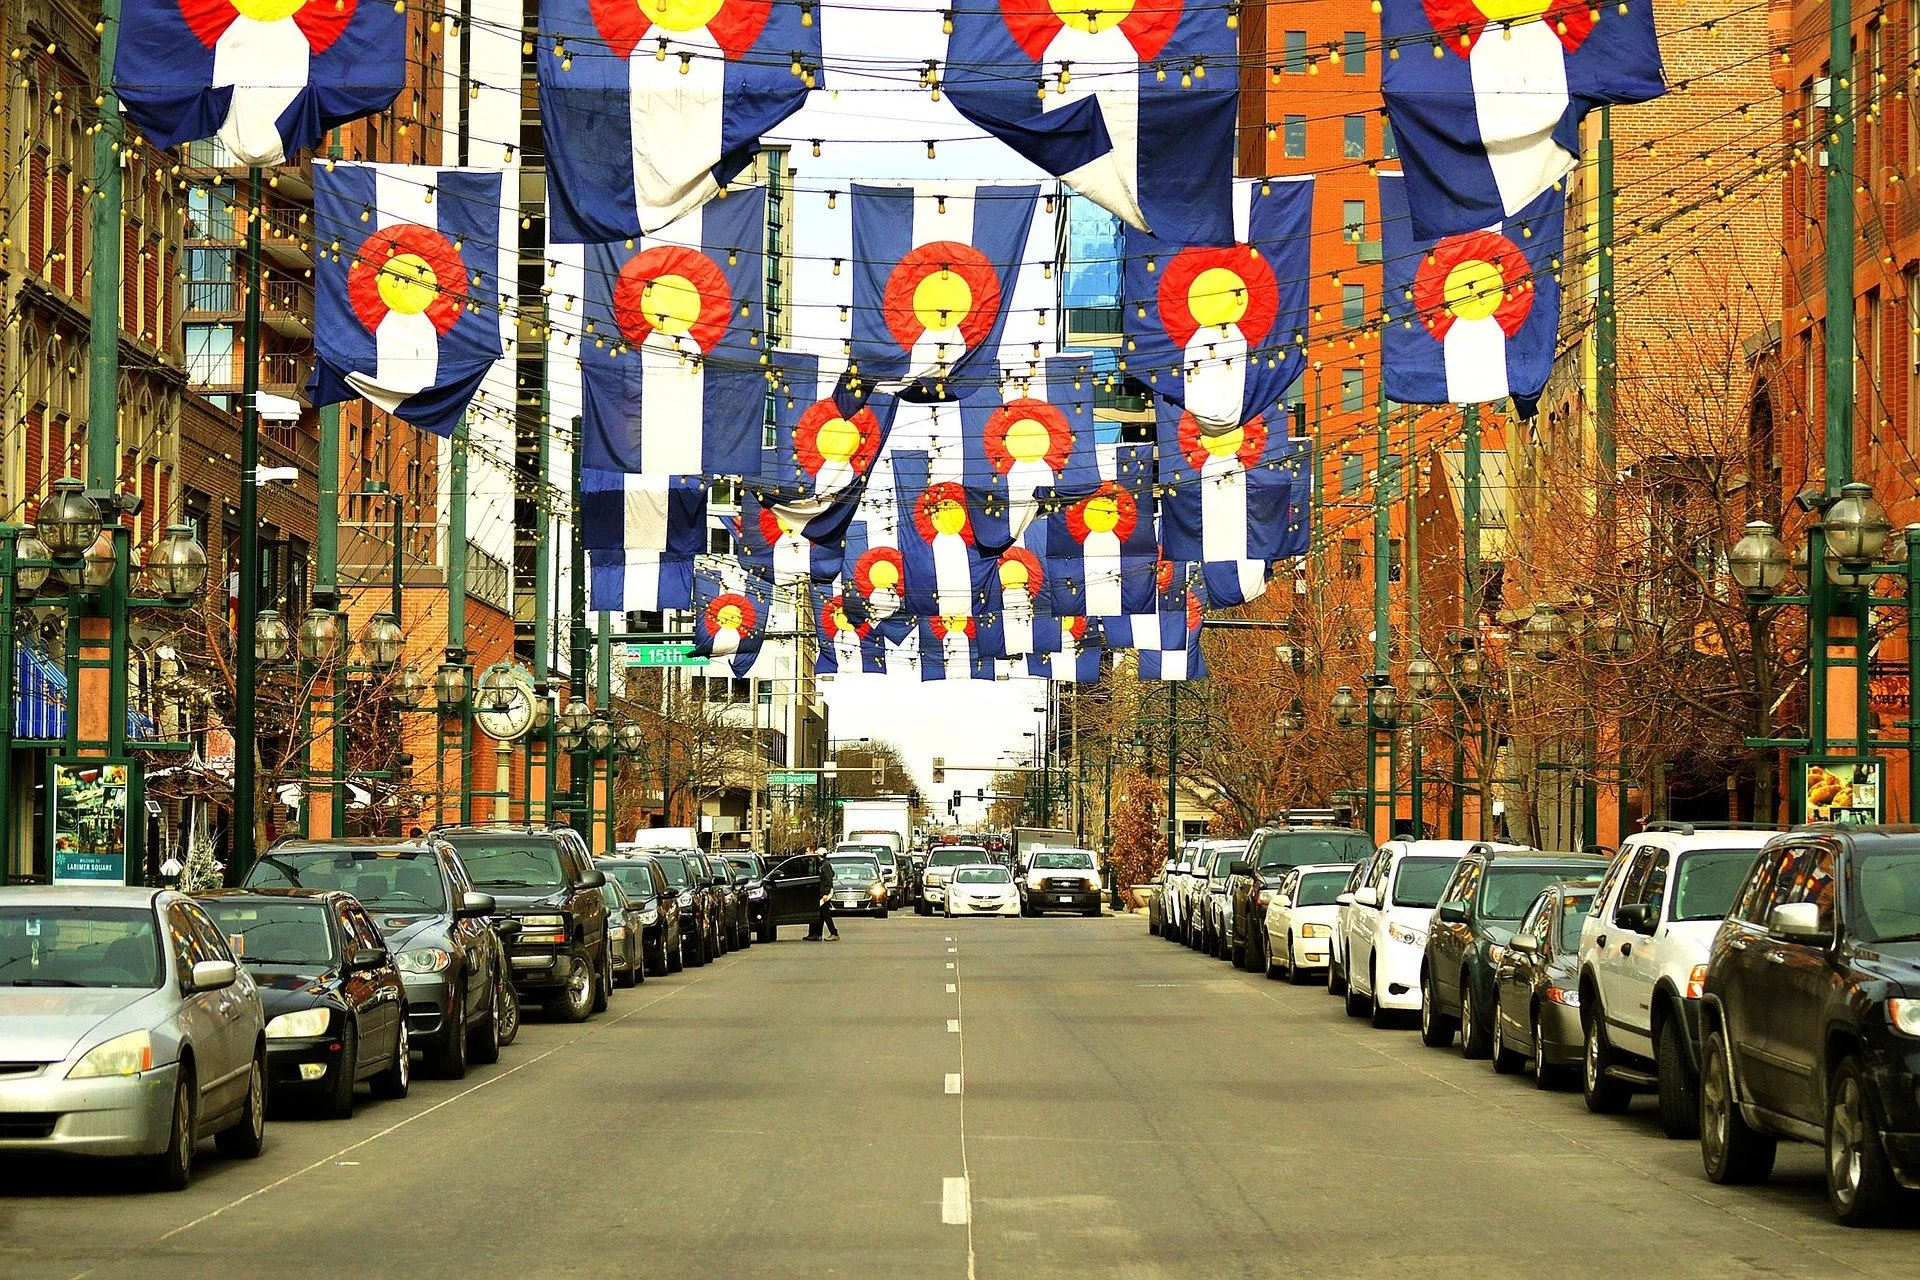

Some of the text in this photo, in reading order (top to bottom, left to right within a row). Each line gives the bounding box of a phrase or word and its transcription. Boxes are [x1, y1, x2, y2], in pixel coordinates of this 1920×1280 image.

[648, 648, 683, 662] 15th
[786, 775, 803, 783] Street
[67, 863, 112, 871] LARIMER SQUARE
